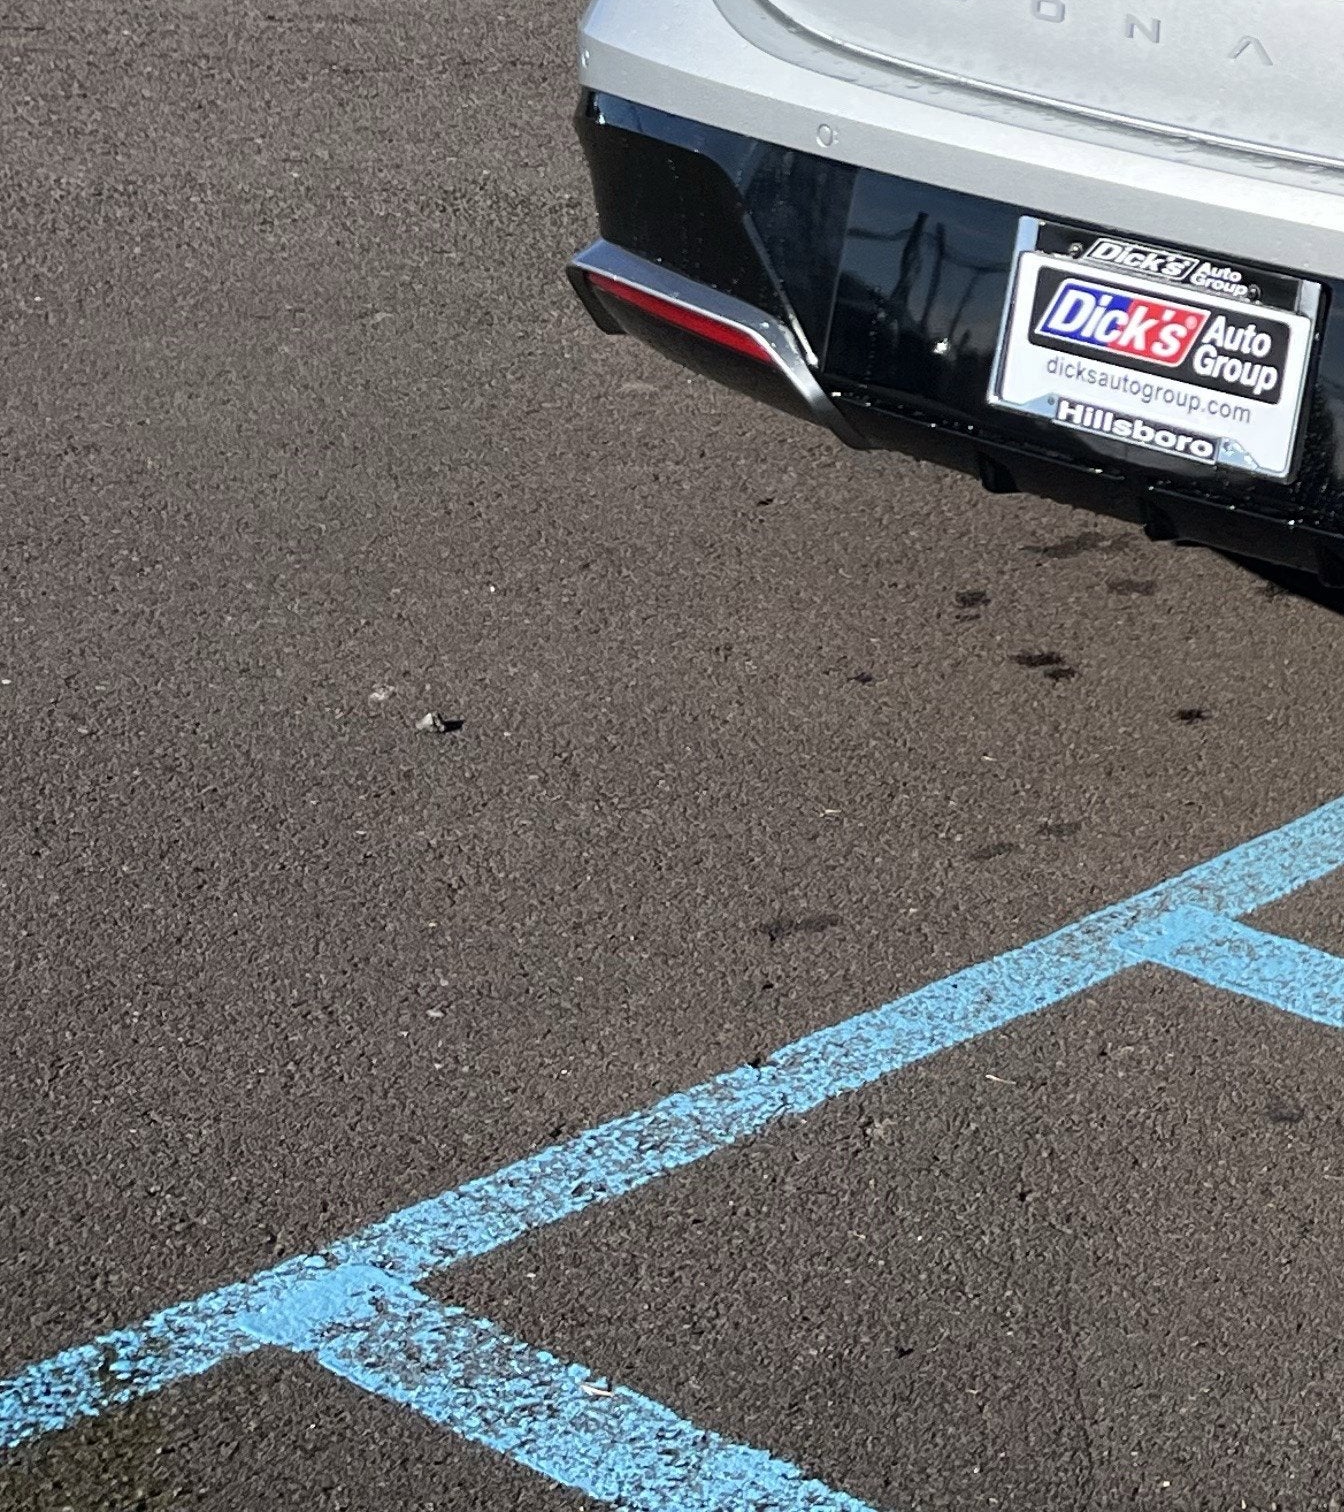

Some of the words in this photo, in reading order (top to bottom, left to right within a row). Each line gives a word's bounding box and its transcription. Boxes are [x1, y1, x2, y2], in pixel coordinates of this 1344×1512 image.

[1091, 241, 1187, 277] Dick's
[1199, 261, 1242, 283] Auto
[1190, 272, 1249, 297] Group
[1047, 289, 1188, 357] Dick's
[1201, 315, 1272, 358] Auto
[1046, 356, 1251, 423] dicksautogroup.com
[1192, 344, 1278, 395] Group
[1057, 400, 1214, 458] Hillsboro
